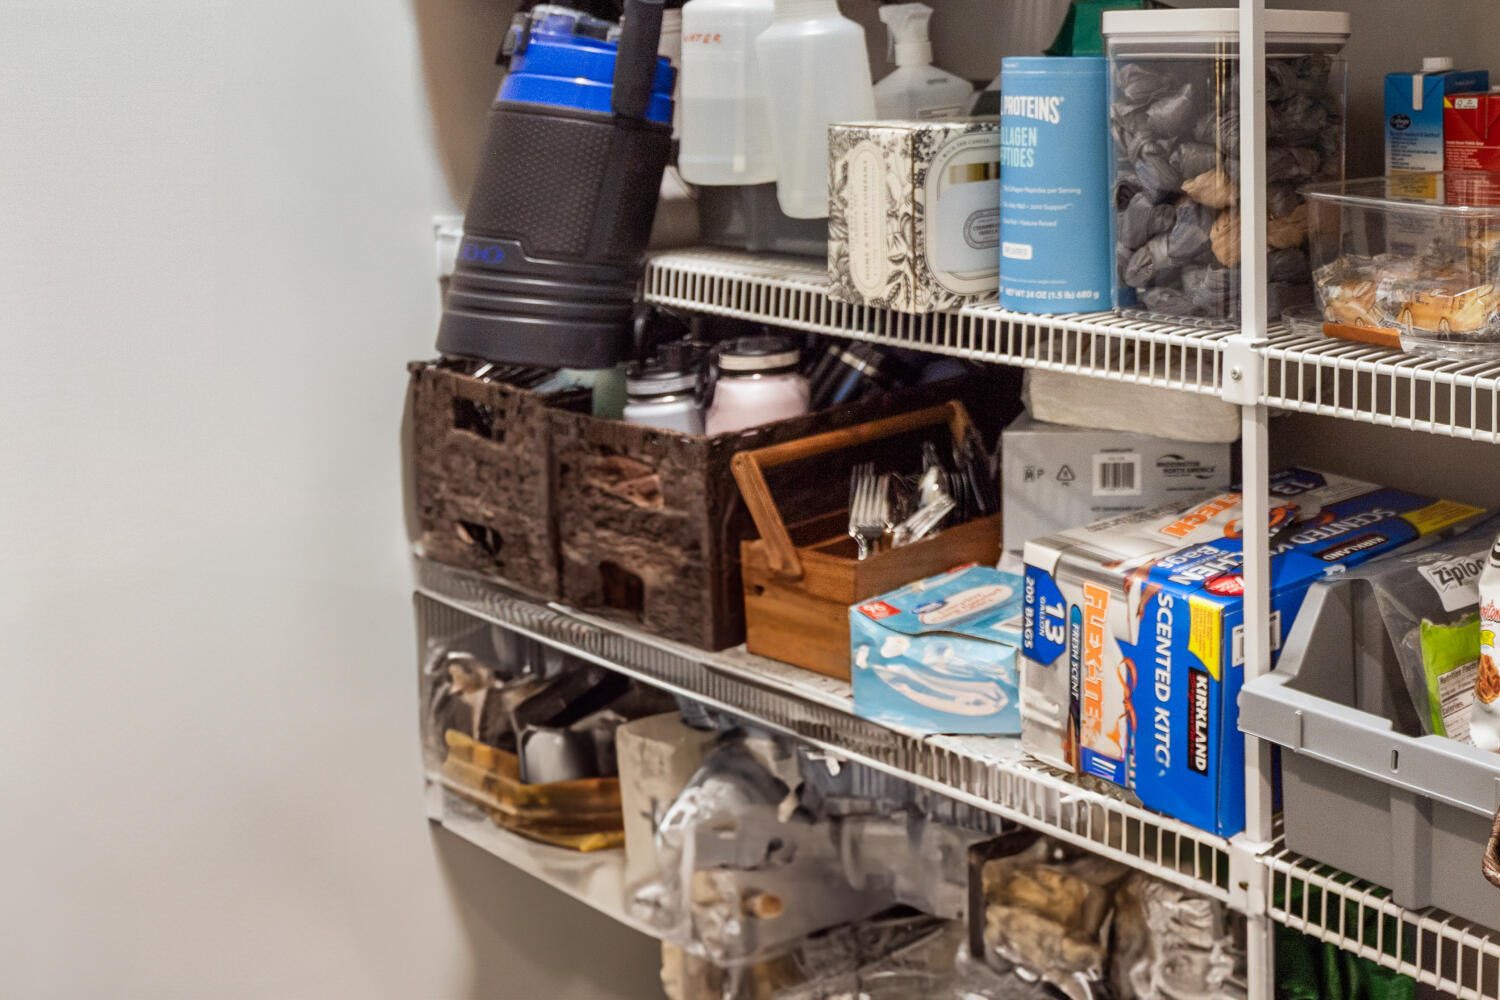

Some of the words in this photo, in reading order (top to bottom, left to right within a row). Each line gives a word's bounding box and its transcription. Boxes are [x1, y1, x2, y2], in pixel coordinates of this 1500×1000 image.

[1004, 96, 1060, 124] PROTEINS
[1290, 508, 1395, 545] SCENTED
[1156, 545, 1220, 570] Bags
[1322, 535, 1383, 561] KIRKLAND
[1025, 576, 1035, 604] 200
[1023, 607, 1035, 649] BAGS
[1039, 596, 1047, 637] GALLON
[1043, 602, 1066, 646] 13
[1072, 624, 1081, 664] FRESH
[1154, 592, 1173, 702] SCENTED
[1071, 666, 1080, 700] SCENT
[1193, 676, 1208, 772] KIRKLAND
